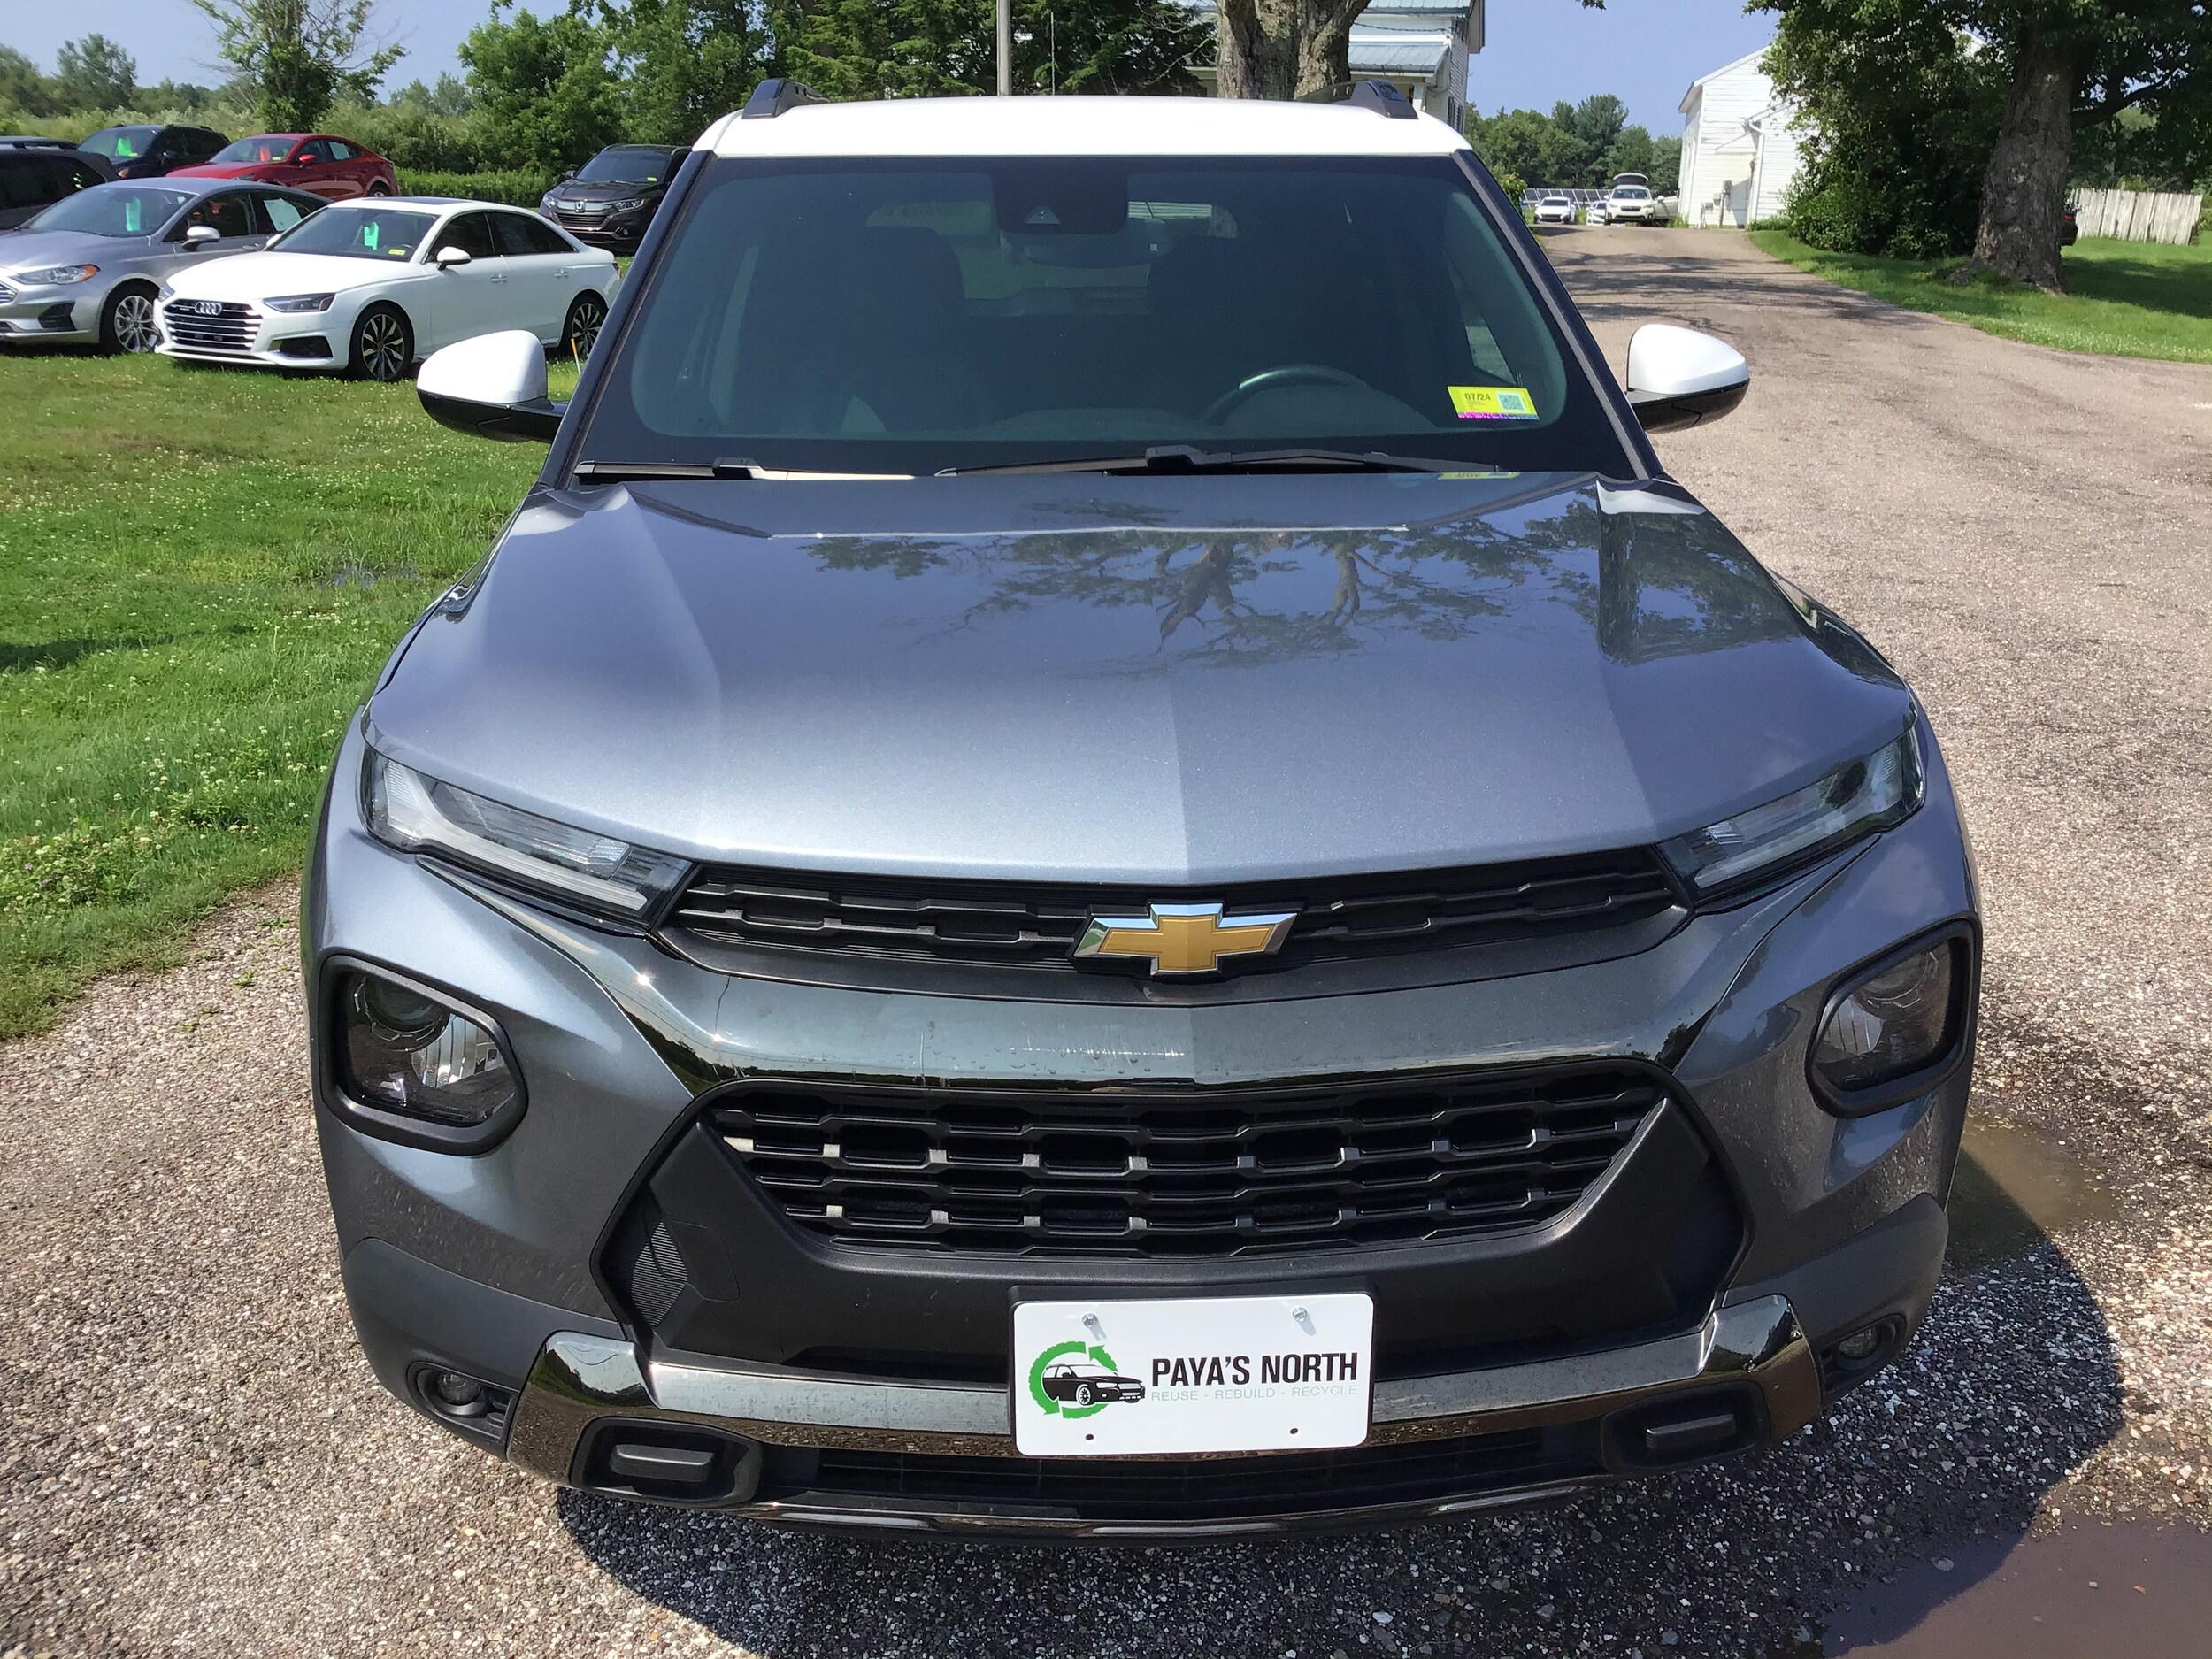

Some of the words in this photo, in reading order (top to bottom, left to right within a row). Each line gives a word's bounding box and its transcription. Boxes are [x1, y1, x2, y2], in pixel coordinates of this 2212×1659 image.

[1152, 1356, 1250, 1386] PAYA'S
[1261, 1353, 1357, 1383] NORTH
[1152, 1390, 1198, 1402] REUSE
[1215, 1388, 1275, 1400] REBUILD
[1291, 1386, 1357, 1397] RECYCLE
